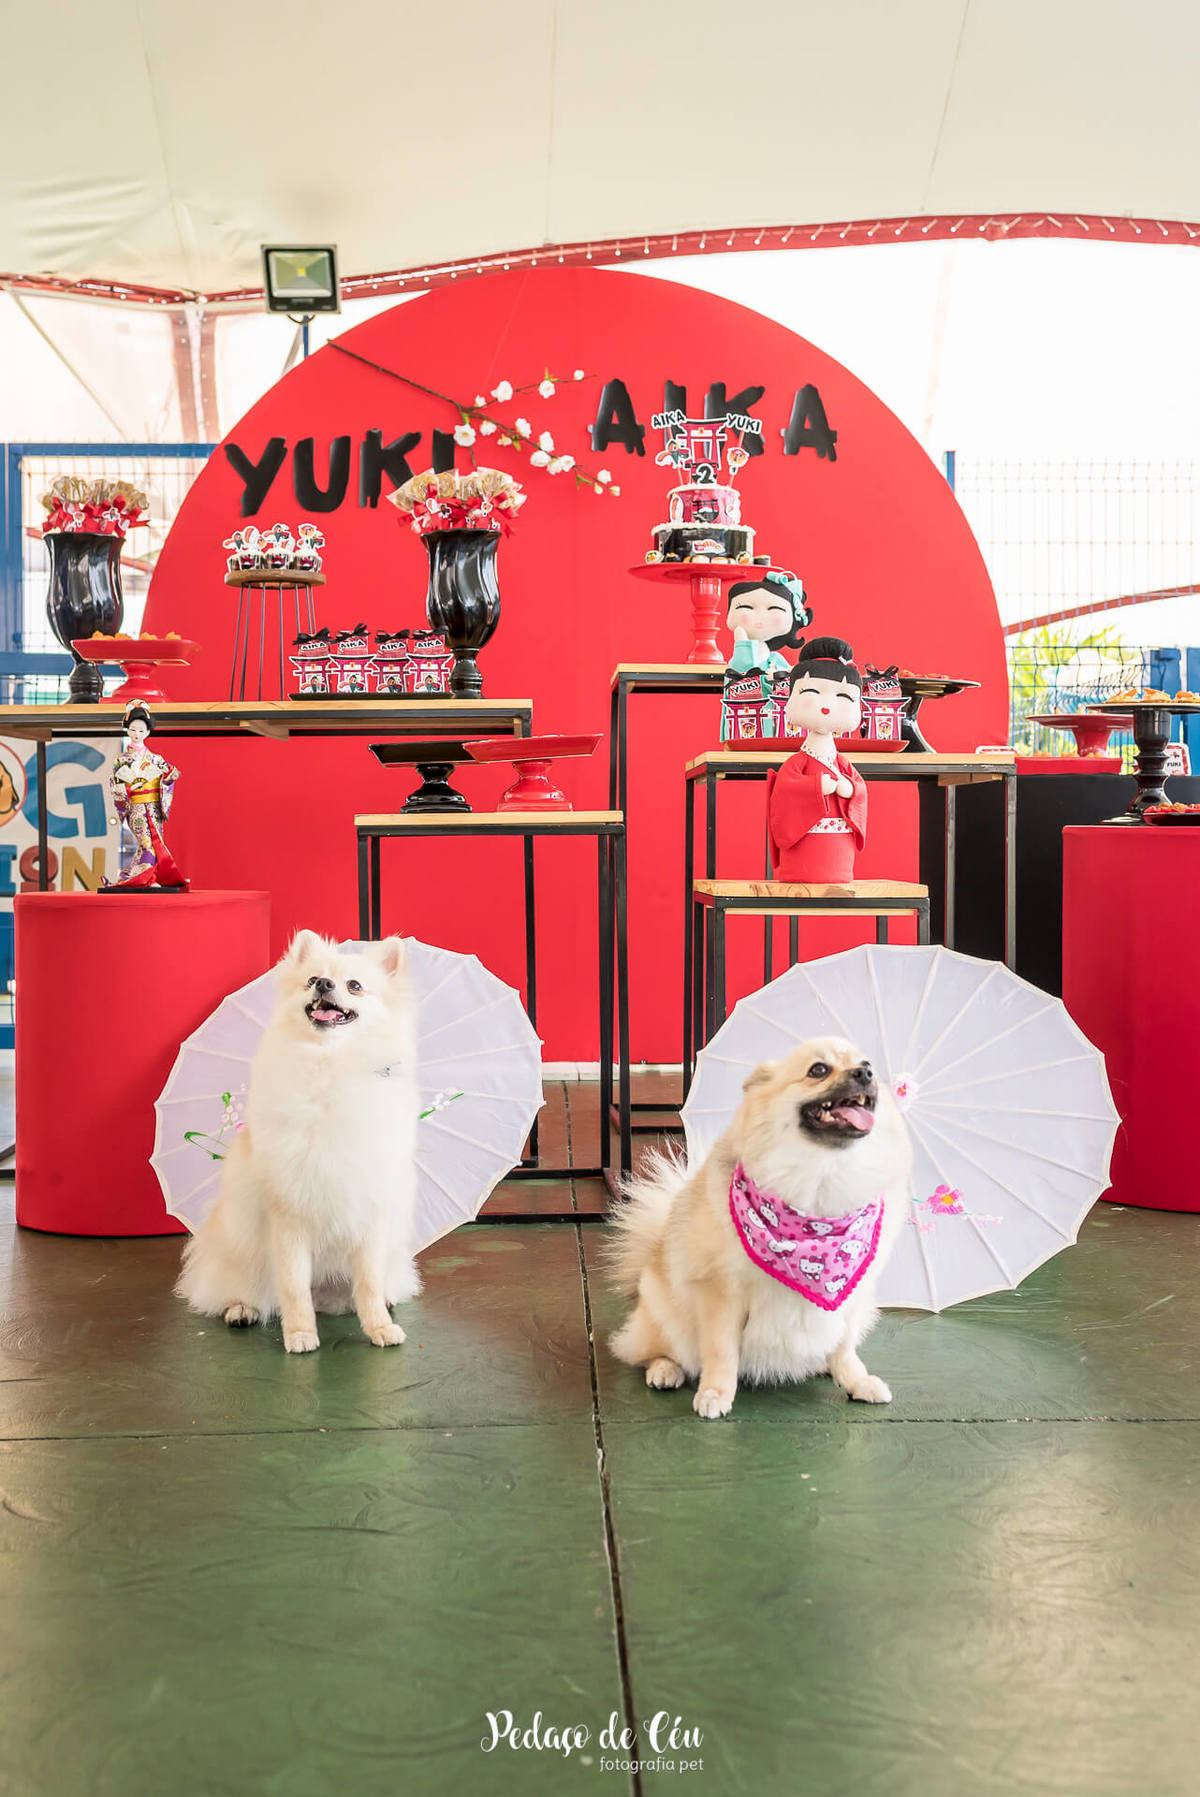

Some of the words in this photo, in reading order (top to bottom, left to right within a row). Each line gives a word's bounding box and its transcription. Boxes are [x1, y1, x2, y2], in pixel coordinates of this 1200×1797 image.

[588, 379, 838, 462] AIKA
[652, 410, 686, 428] AIKA
[726, 415, 761, 432] YUKI
[223, 427, 456, 518] YUKI
[699, 465, 716, 484] 2
[302, 642, 326, 650] AIKA
[340, 640, 365, 649] AIKA
[381, 642, 405, 650] AIKA
[417, 640, 442, 648] AIKA
[732, 681, 759, 693] YUKI
[872, 680, 897, 690] YUKI
